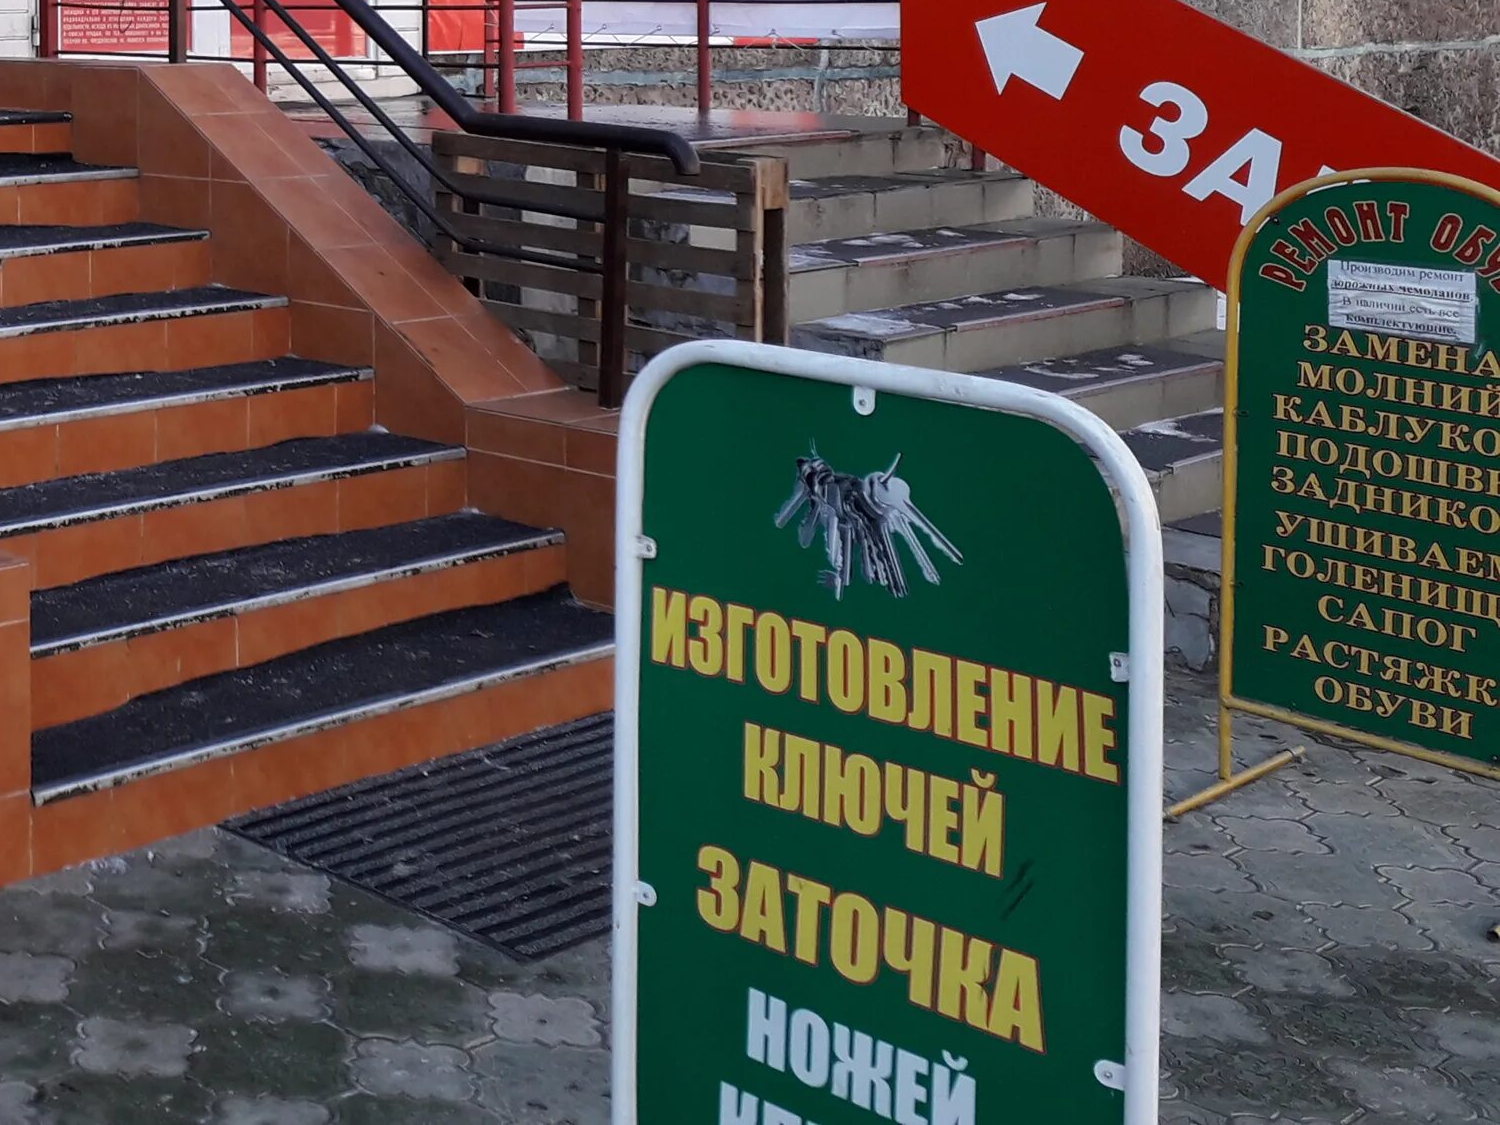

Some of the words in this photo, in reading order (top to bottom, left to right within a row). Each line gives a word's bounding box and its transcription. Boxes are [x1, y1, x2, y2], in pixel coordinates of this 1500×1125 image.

[1119, 81, 1340, 227] ЗА
[1259, 200, 1409, 291] РЕМОНТ
[1430, 213, 1500, 294] ОБУ
[1419, 270, 1464, 283] ремонт
[650, 586, 1121, 784] ИЗГОТОВЛЕНИЕ
[1317, 594, 1478, 654] САПОГ
[1314, 675, 1474, 740] ОБУВИ
[742, 721, 1004, 880] КЛЮЧЕЙ
[696, 844, 1046, 1054] ЗАТОЧКА
[746, 987, 977, 1125] НОЖЕЙ
